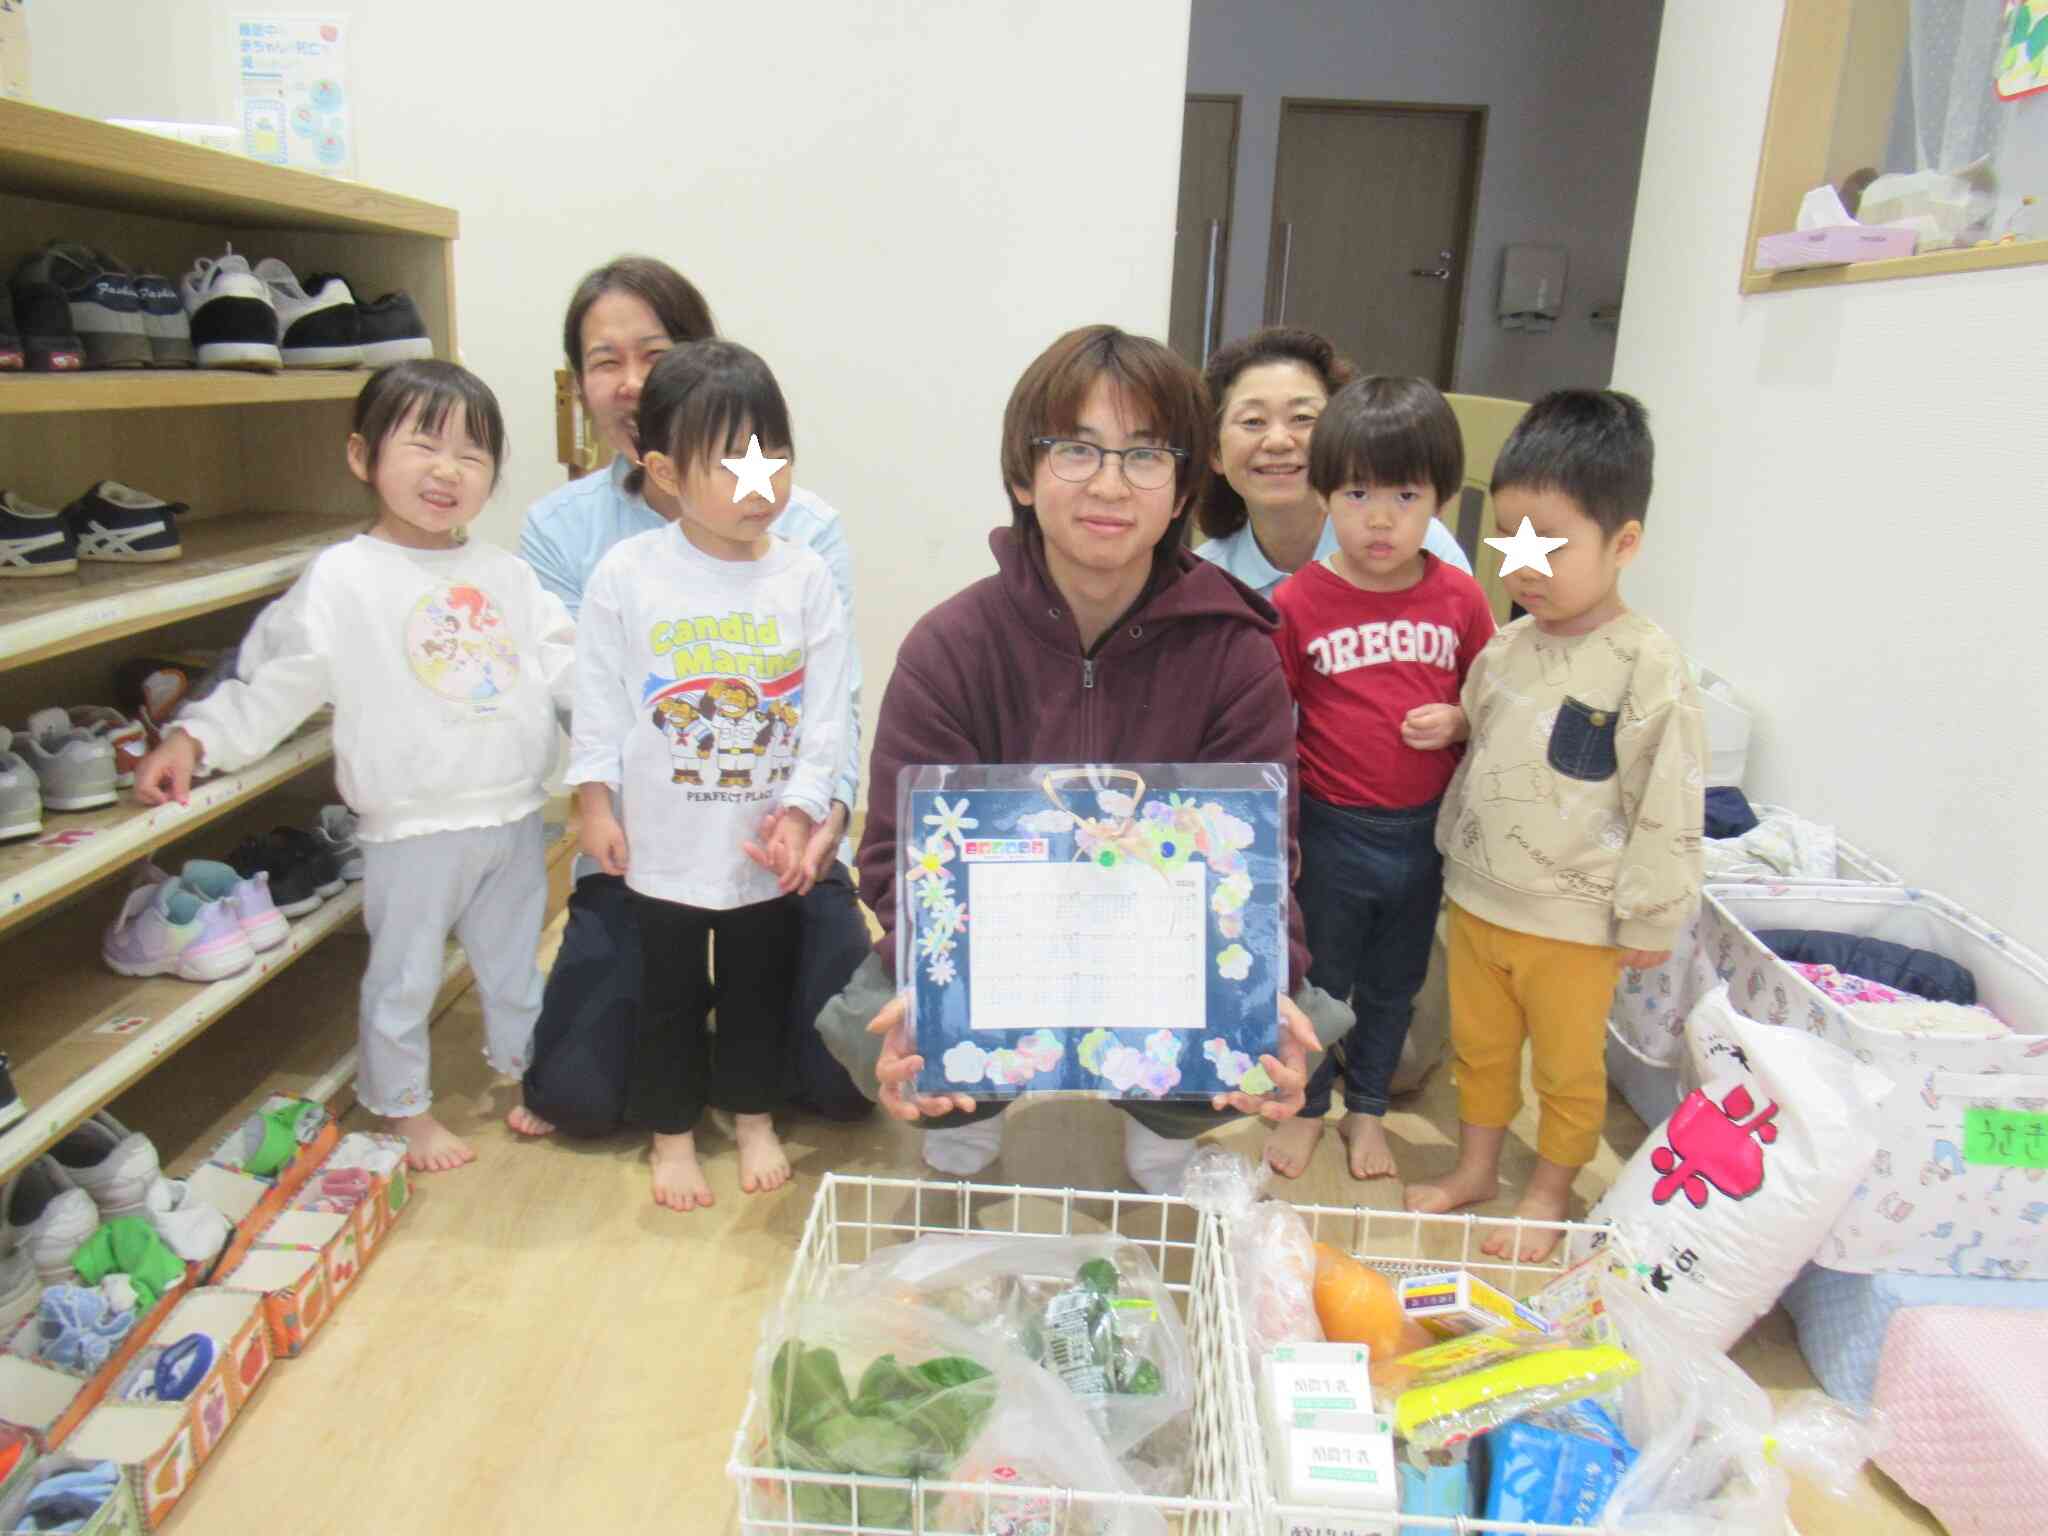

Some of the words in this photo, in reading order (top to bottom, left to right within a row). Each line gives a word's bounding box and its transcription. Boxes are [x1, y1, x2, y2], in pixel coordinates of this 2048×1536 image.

[651, 612, 779, 656] Candid
[1307, 620, 1460, 676] OREGON
[687, 791, 743, 802] PERFECT
